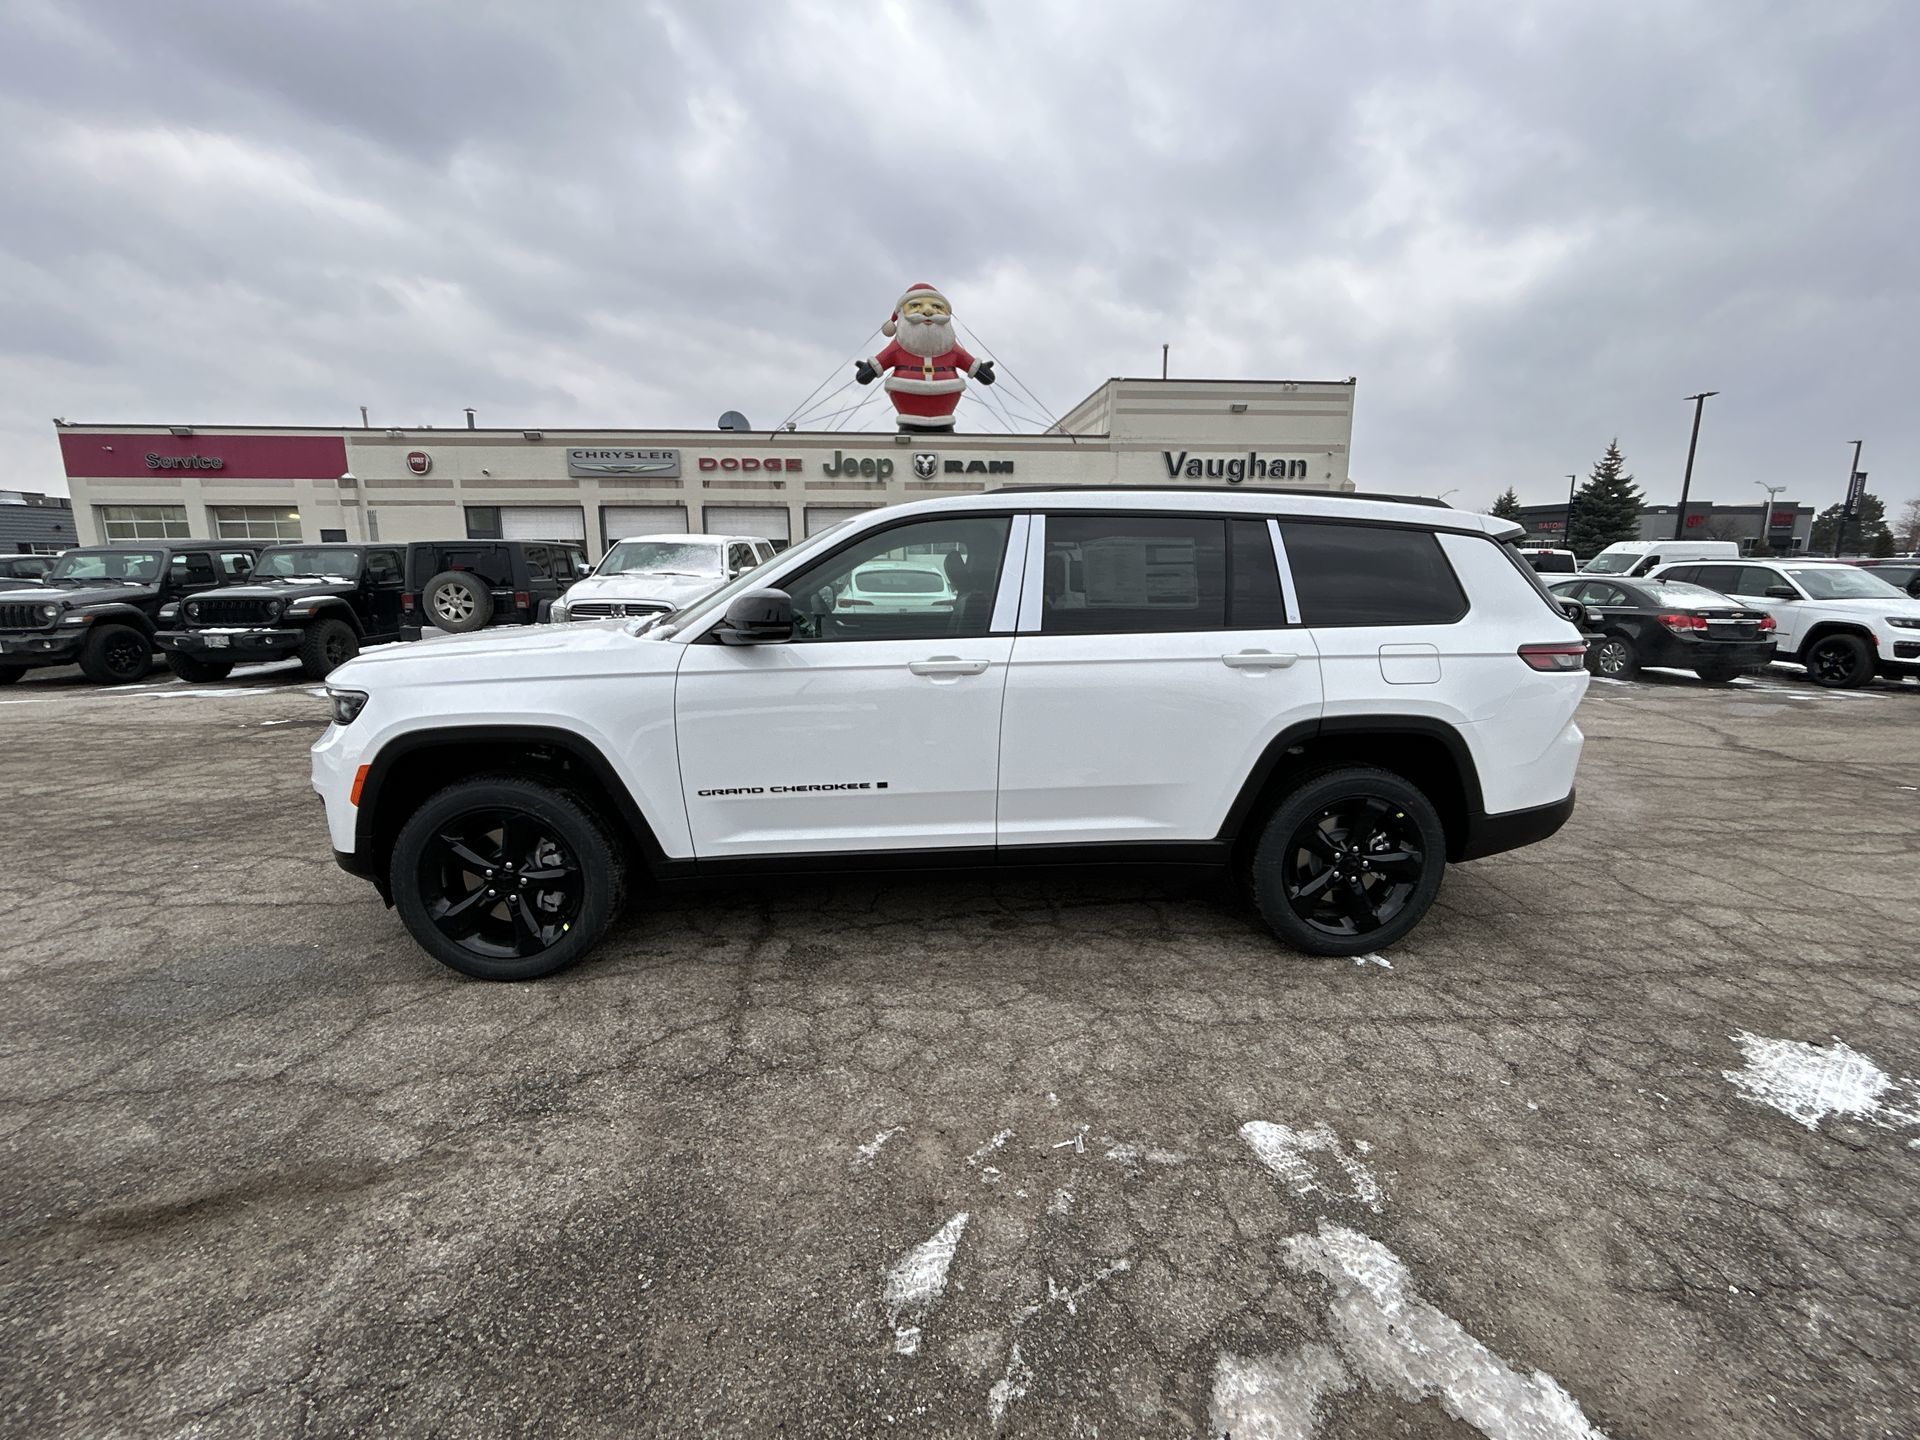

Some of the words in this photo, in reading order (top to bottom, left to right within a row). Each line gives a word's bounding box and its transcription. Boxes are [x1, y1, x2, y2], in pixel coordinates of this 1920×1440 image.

[145, 452, 223, 469] Service
[573, 451, 673, 459] CHRYSLER
[699, 458, 802, 472] DODGE
[823, 450, 895, 484] Jeep
[944, 460, 1014, 474] RAM
[1163, 451, 1308, 485] Vaughan
[698, 786, 765, 797] GRAND
[770, 782, 872, 793] CHEROKEE
